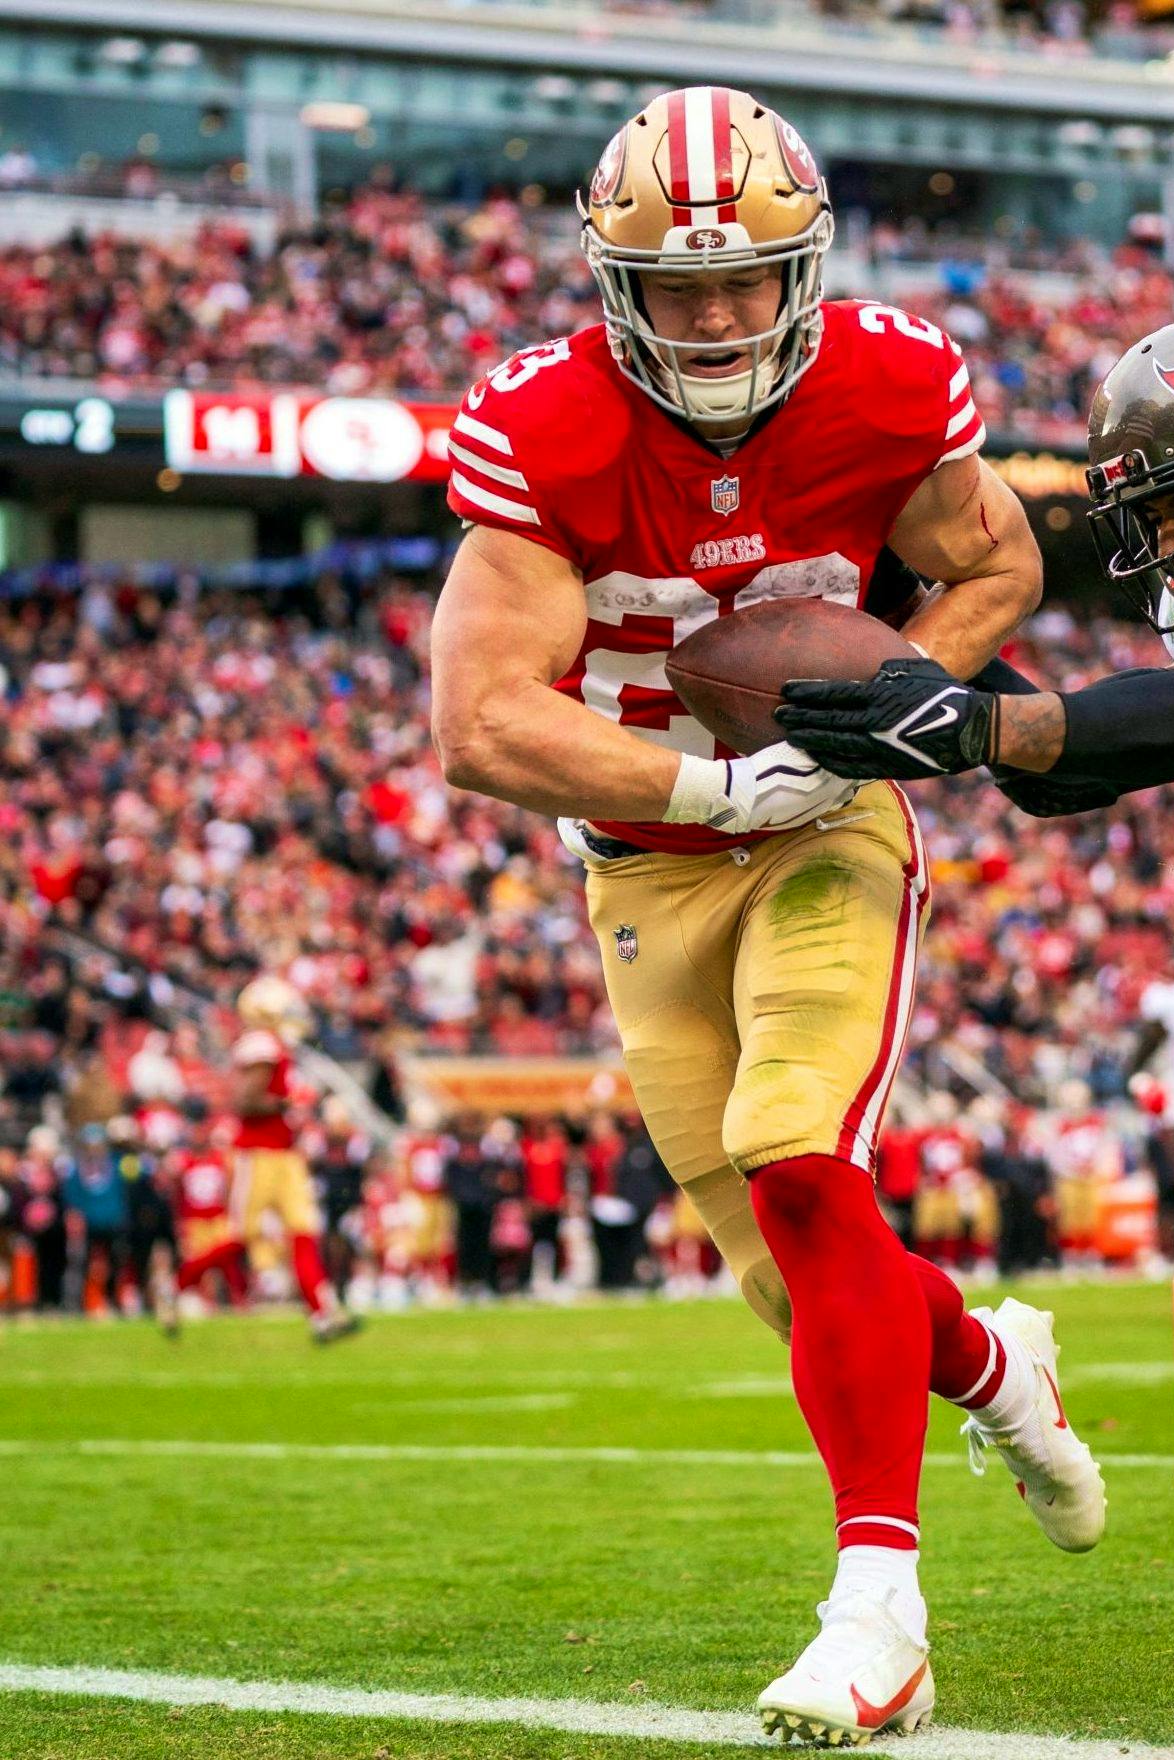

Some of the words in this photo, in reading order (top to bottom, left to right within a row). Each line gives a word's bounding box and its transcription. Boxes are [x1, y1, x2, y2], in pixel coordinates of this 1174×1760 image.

[857, 304, 963, 356] 2
[467, 338, 572, 411] 3
[715, 491, 738, 510] NFL
[690, 533, 767, 569] 49ERS
[580, 551, 861, 761] 2
